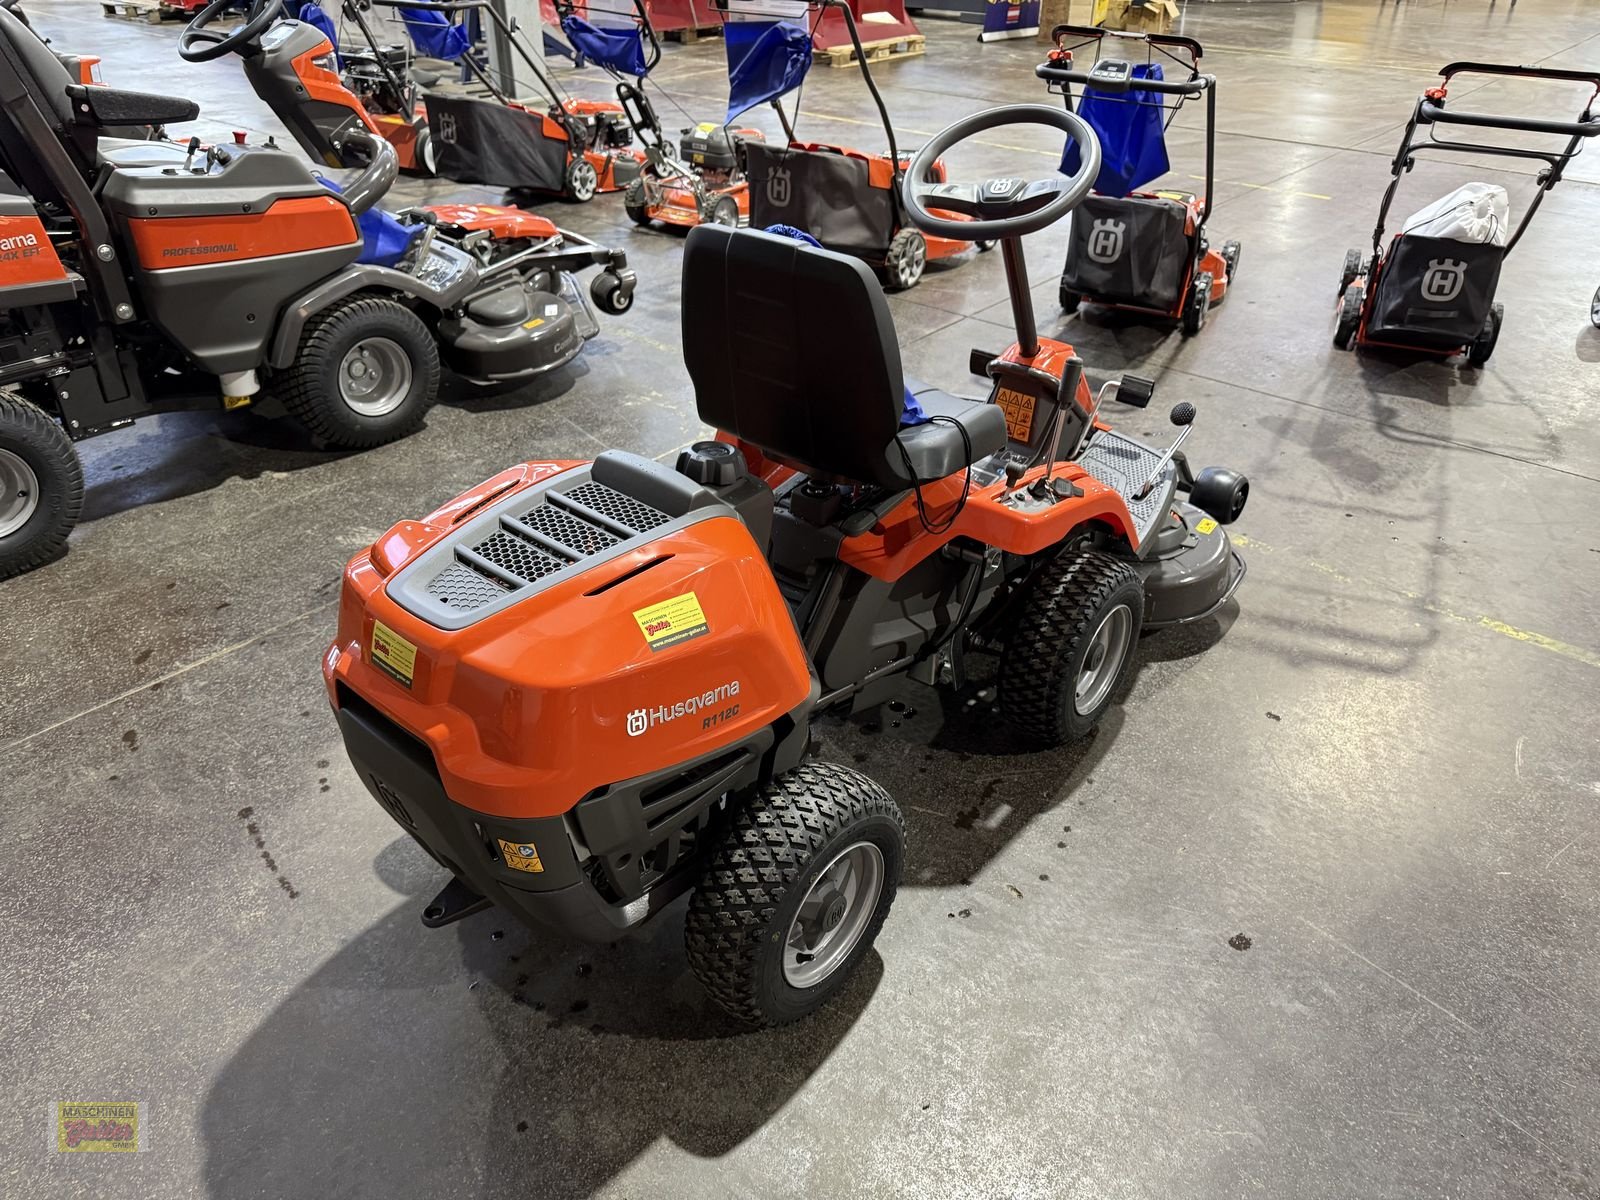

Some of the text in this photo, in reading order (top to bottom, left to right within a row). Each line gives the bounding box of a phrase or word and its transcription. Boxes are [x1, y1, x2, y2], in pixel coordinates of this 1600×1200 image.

[0, 233, 38, 251] arna
[162, 243, 239, 257] PROFESSIONAL
[23, 247, 40, 258] EFI
[649, 680, 740, 728] Husqvarna
[702, 704, 740, 730] R112C
